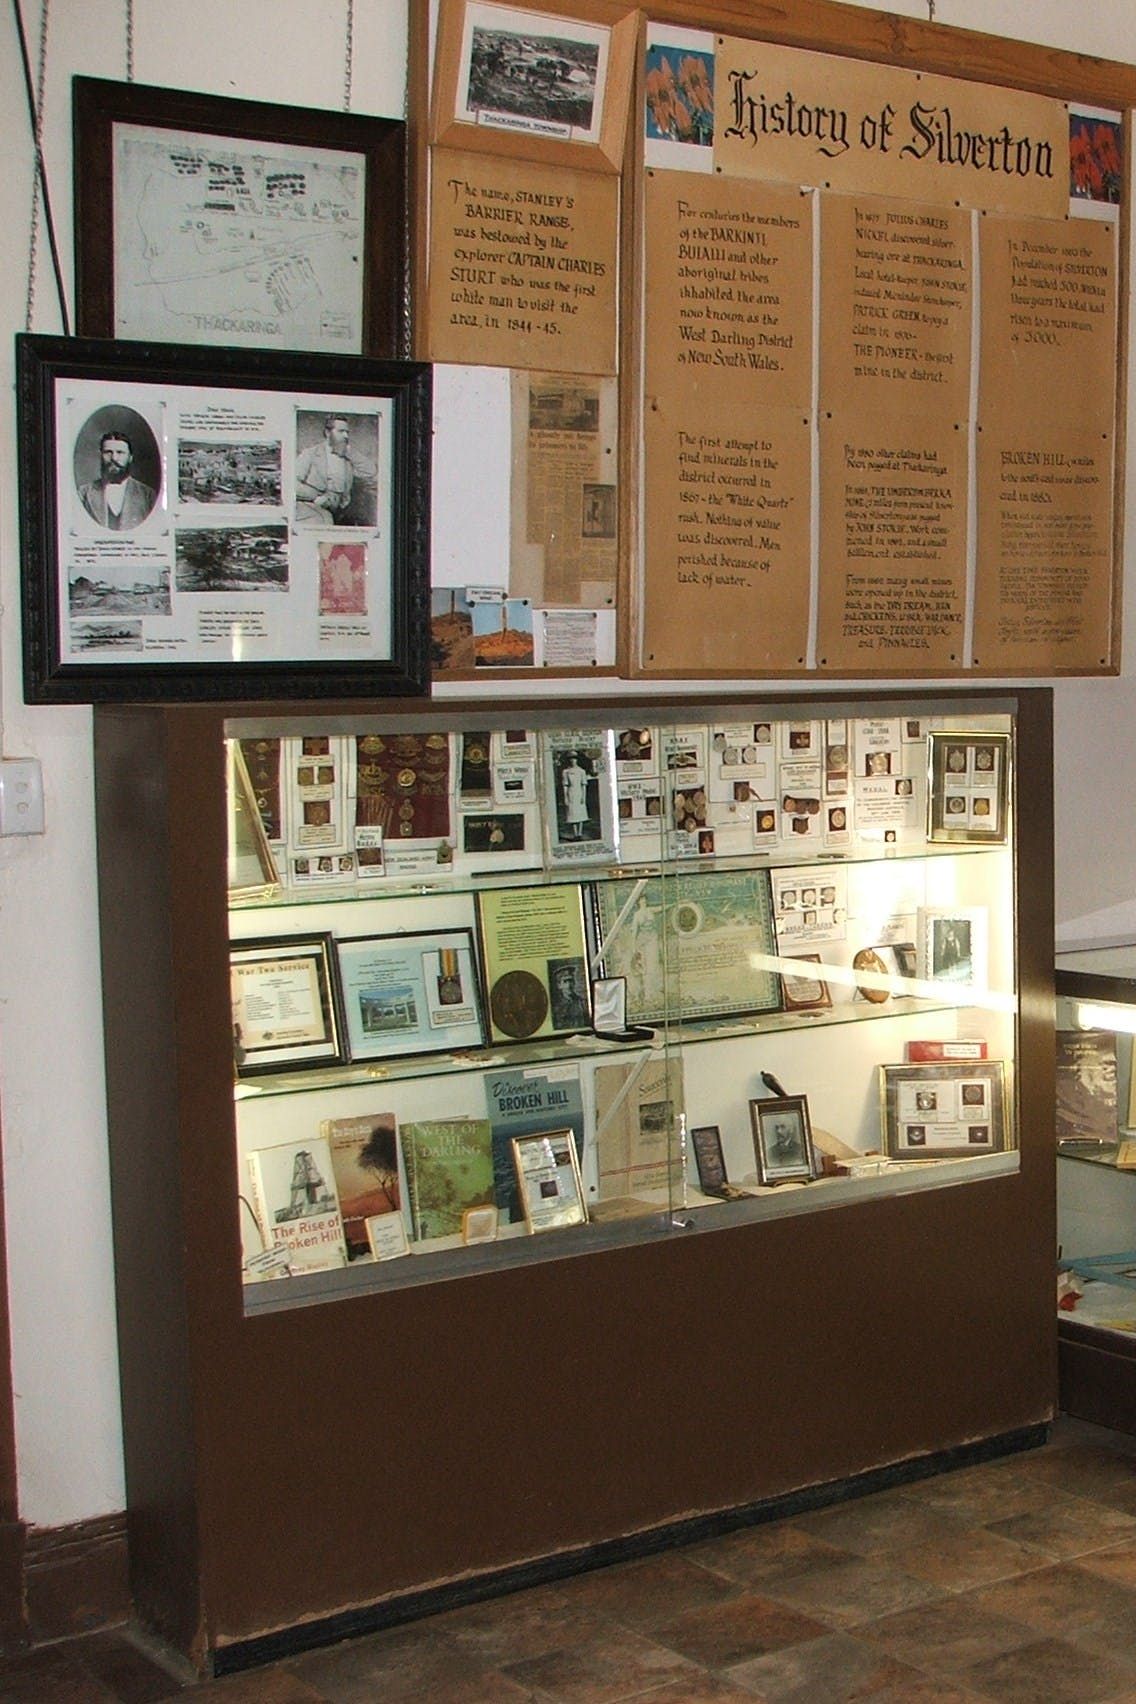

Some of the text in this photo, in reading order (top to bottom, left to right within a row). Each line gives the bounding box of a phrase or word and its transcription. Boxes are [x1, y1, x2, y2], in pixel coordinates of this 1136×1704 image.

[724, 70, 1054, 179] History of Silverton
[448, 180, 477, 203] The
[465, 204, 523, 225] BARRIER
[454, 228, 477, 239] was
[481, 228, 532, 246] bestowed
[508, 251, 556, 270] CAPTAIN
[558, 257, 607, 277] CHARLES
[450, 268, 497, 285] STURT
[451, 288, 484, 305] white
[489, 296, 513, 308] man
[678, 325, 707, 342] West
[711, 328, 756, 351] Darling
[688, 349, 713, 365] New
[678, 431, 698, 449] The
[499, 1092, 542, 1112] BROKEN
[547, 1089, 569, 1105] HILL
[419, 1122, 479, 1137] WEST OF
[440, 1135, 465, 1146] THE
[421, 1145, 481, 1158] DARLING
[272, 1215, 340, 1240] The Rise of
[273, 1228, 342, 1249] Boken Hill
